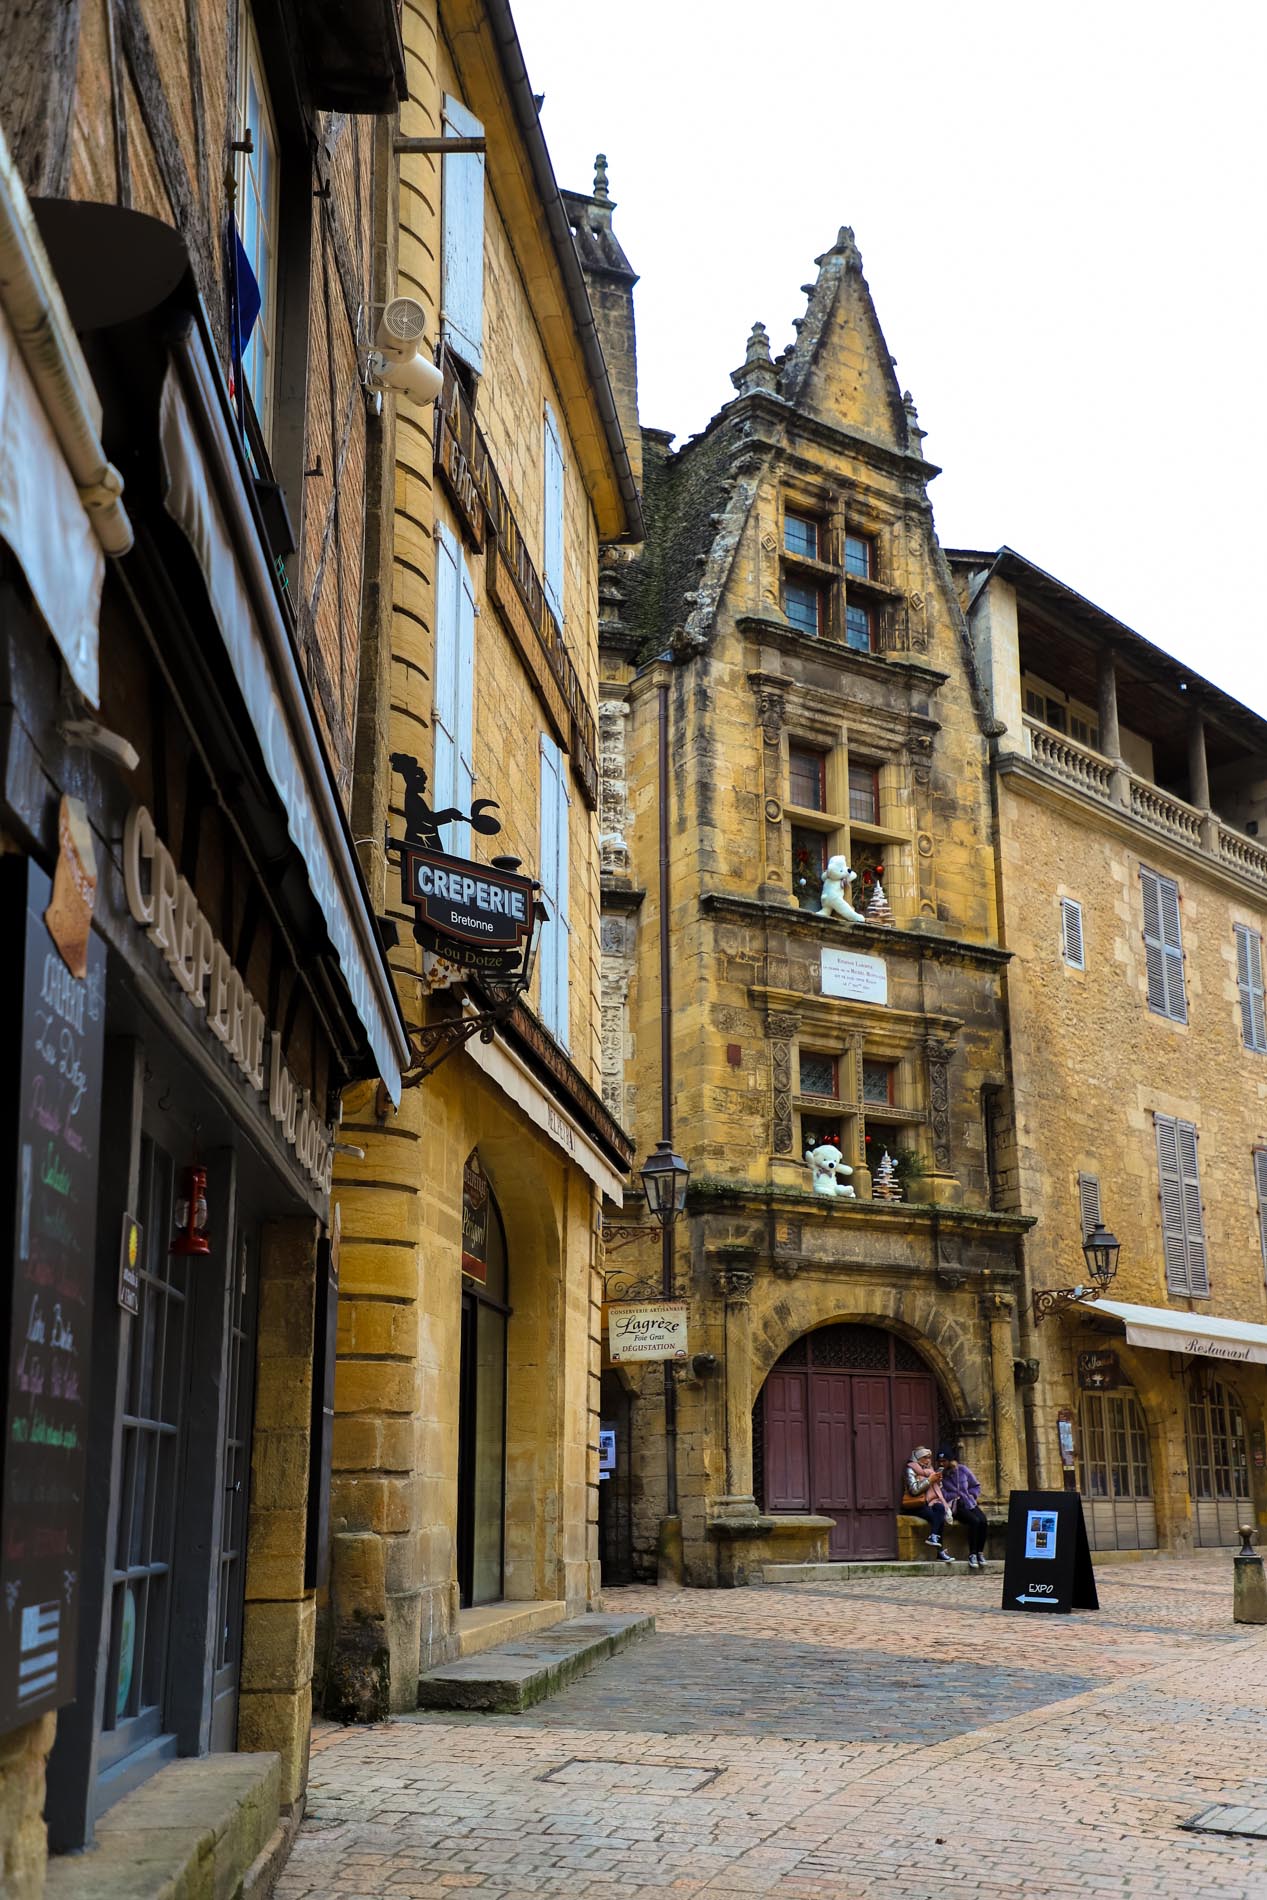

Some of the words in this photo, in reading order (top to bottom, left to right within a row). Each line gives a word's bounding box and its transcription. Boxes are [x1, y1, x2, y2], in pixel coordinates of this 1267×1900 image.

[450, 440, 479, 529] GROS
[418, 865, 526, 921] CREPERIE
[450, 911, 494, 932] Bretonne
[123, 805, 265, 1091] CREPERIE
[434, 937, 460, 960] Lou
[464, 951, 504, 968] Dotze
[615, 1315, 680, 1337] Lagrèze
[622, 1342, 676, 1352] DÉGUSTATION
[634, 1334, 648, 1342] Foie
[649, 1333, 665, 1341] Gras
[1185, 1338, 1252, 1361] Restaurant
[1028, 1583, 1054, 1594] EXPO
